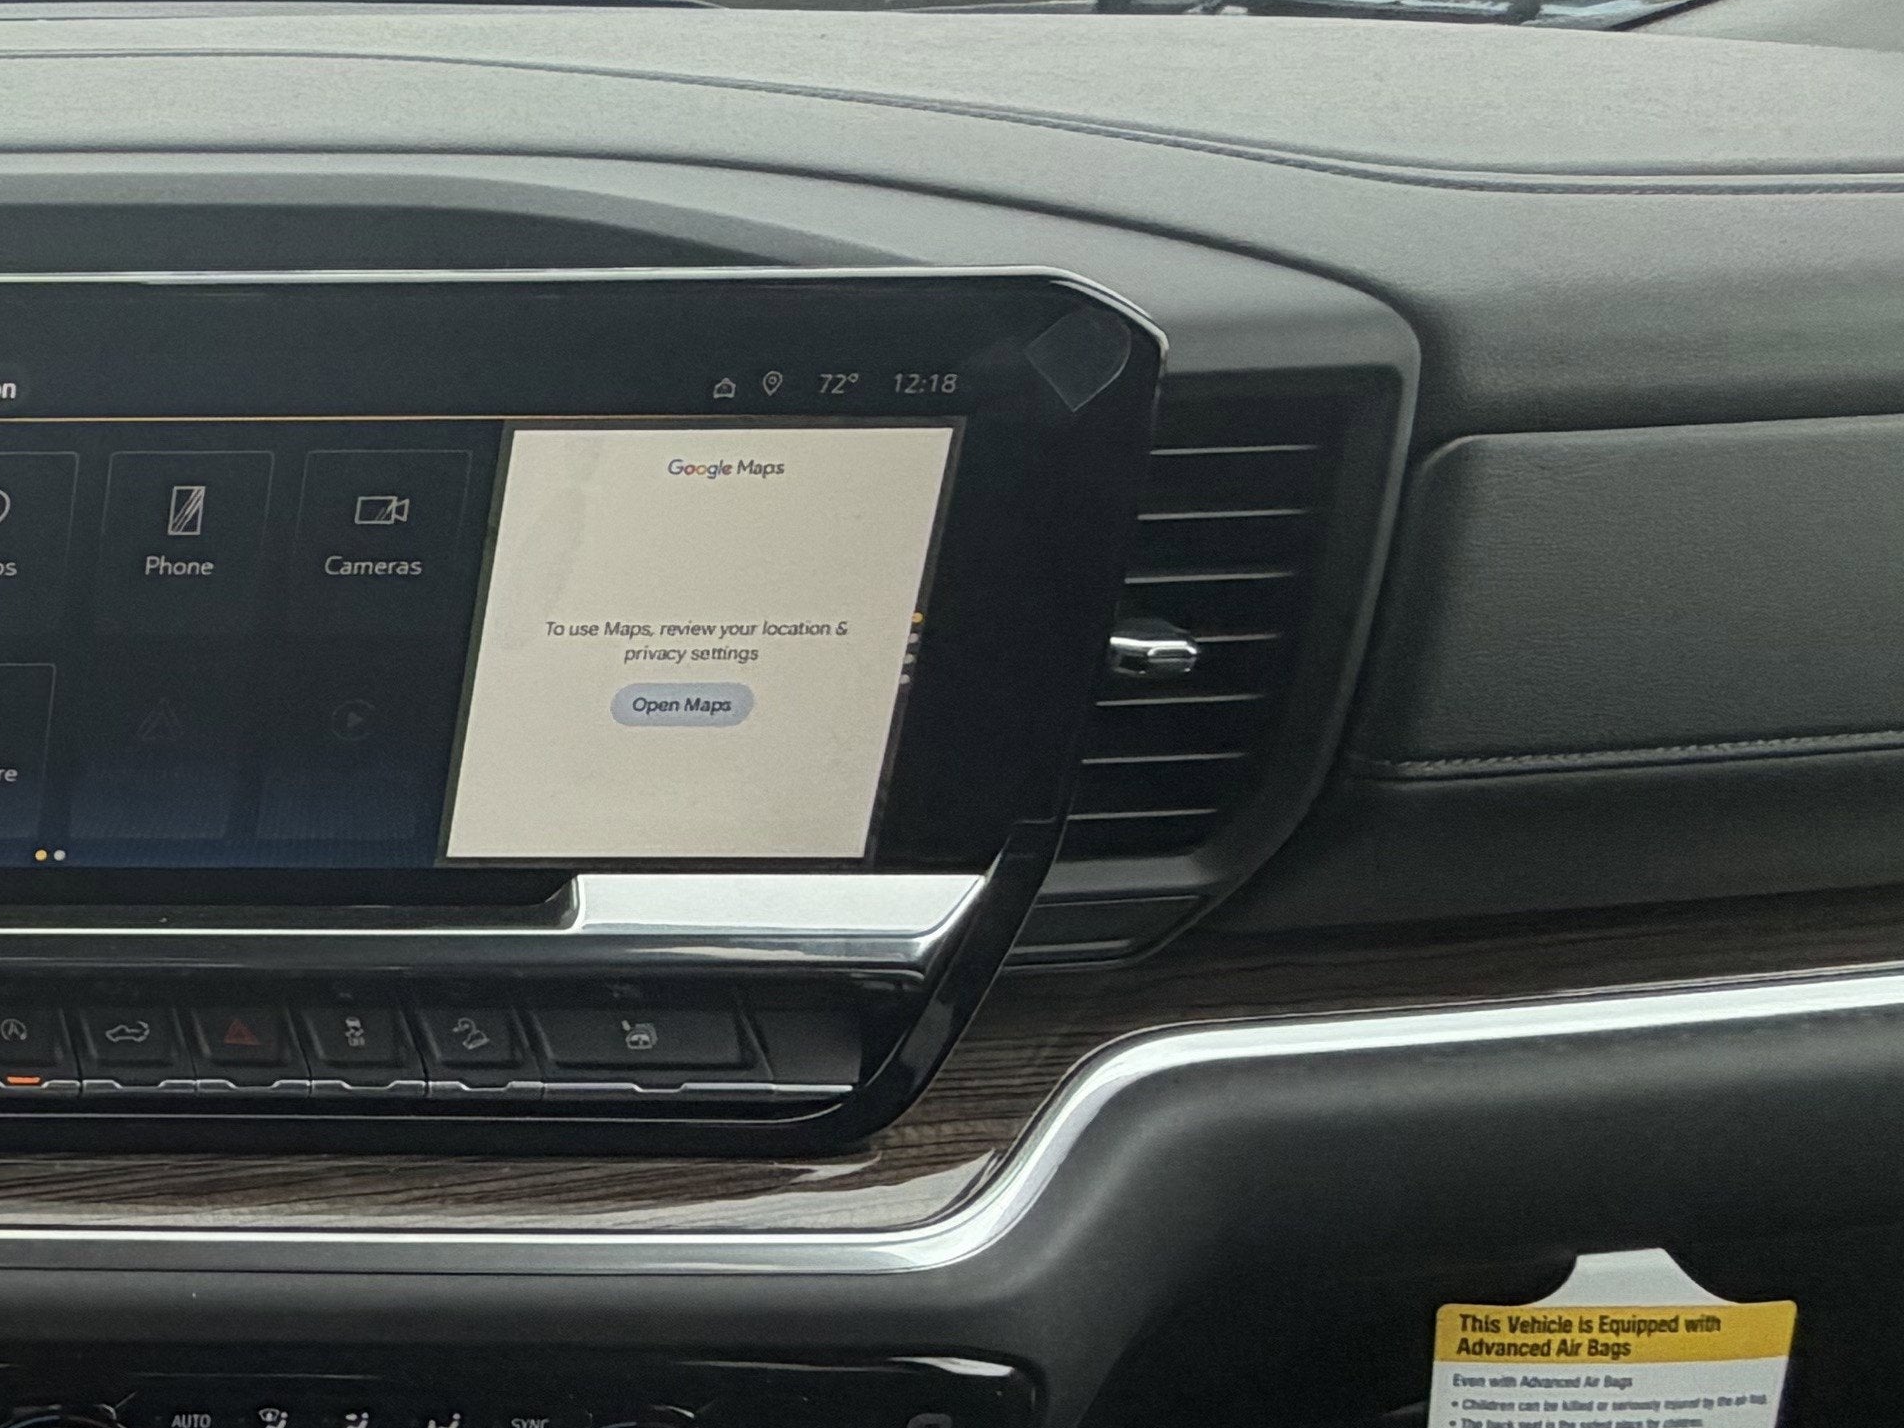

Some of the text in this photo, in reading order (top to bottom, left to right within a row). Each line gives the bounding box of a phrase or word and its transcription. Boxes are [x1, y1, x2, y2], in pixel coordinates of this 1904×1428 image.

[893, 373, 958, 394] 12:18
[668, 458, 785, 479] Google Maps
[144, 556, 214, 576] Phone
[324, 556, 423, 576] Cameras
[545, 621, 848, 641] To use Maps, review your location &
[624, 646, 759, 665] privacy settings
[632, 697, 732, 715] Open Maps
[1459, 1313, 1722, 1338] This Vehicle is Equipped with
[1456, 1338, 1632, 1360] Advanced Air Bags
